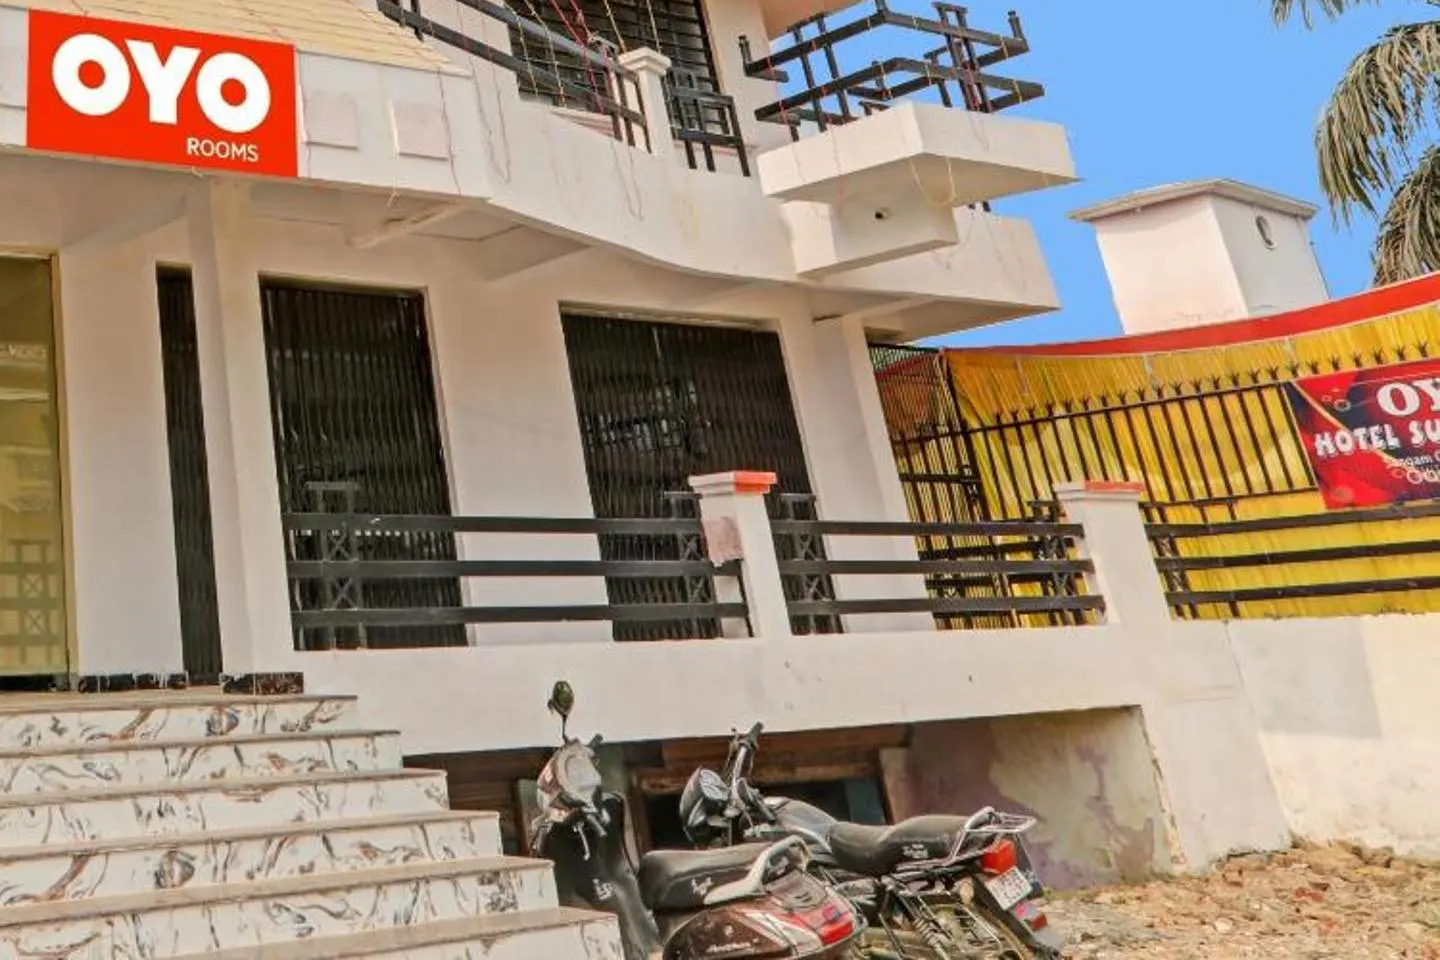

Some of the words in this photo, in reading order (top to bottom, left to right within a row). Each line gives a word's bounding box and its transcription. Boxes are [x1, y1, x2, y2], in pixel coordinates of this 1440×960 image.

[51, 33, 271, 133] OYO
[186, 137, 259, 162] ROOMS
[1314, 424, 1401, 457] HOTEL
